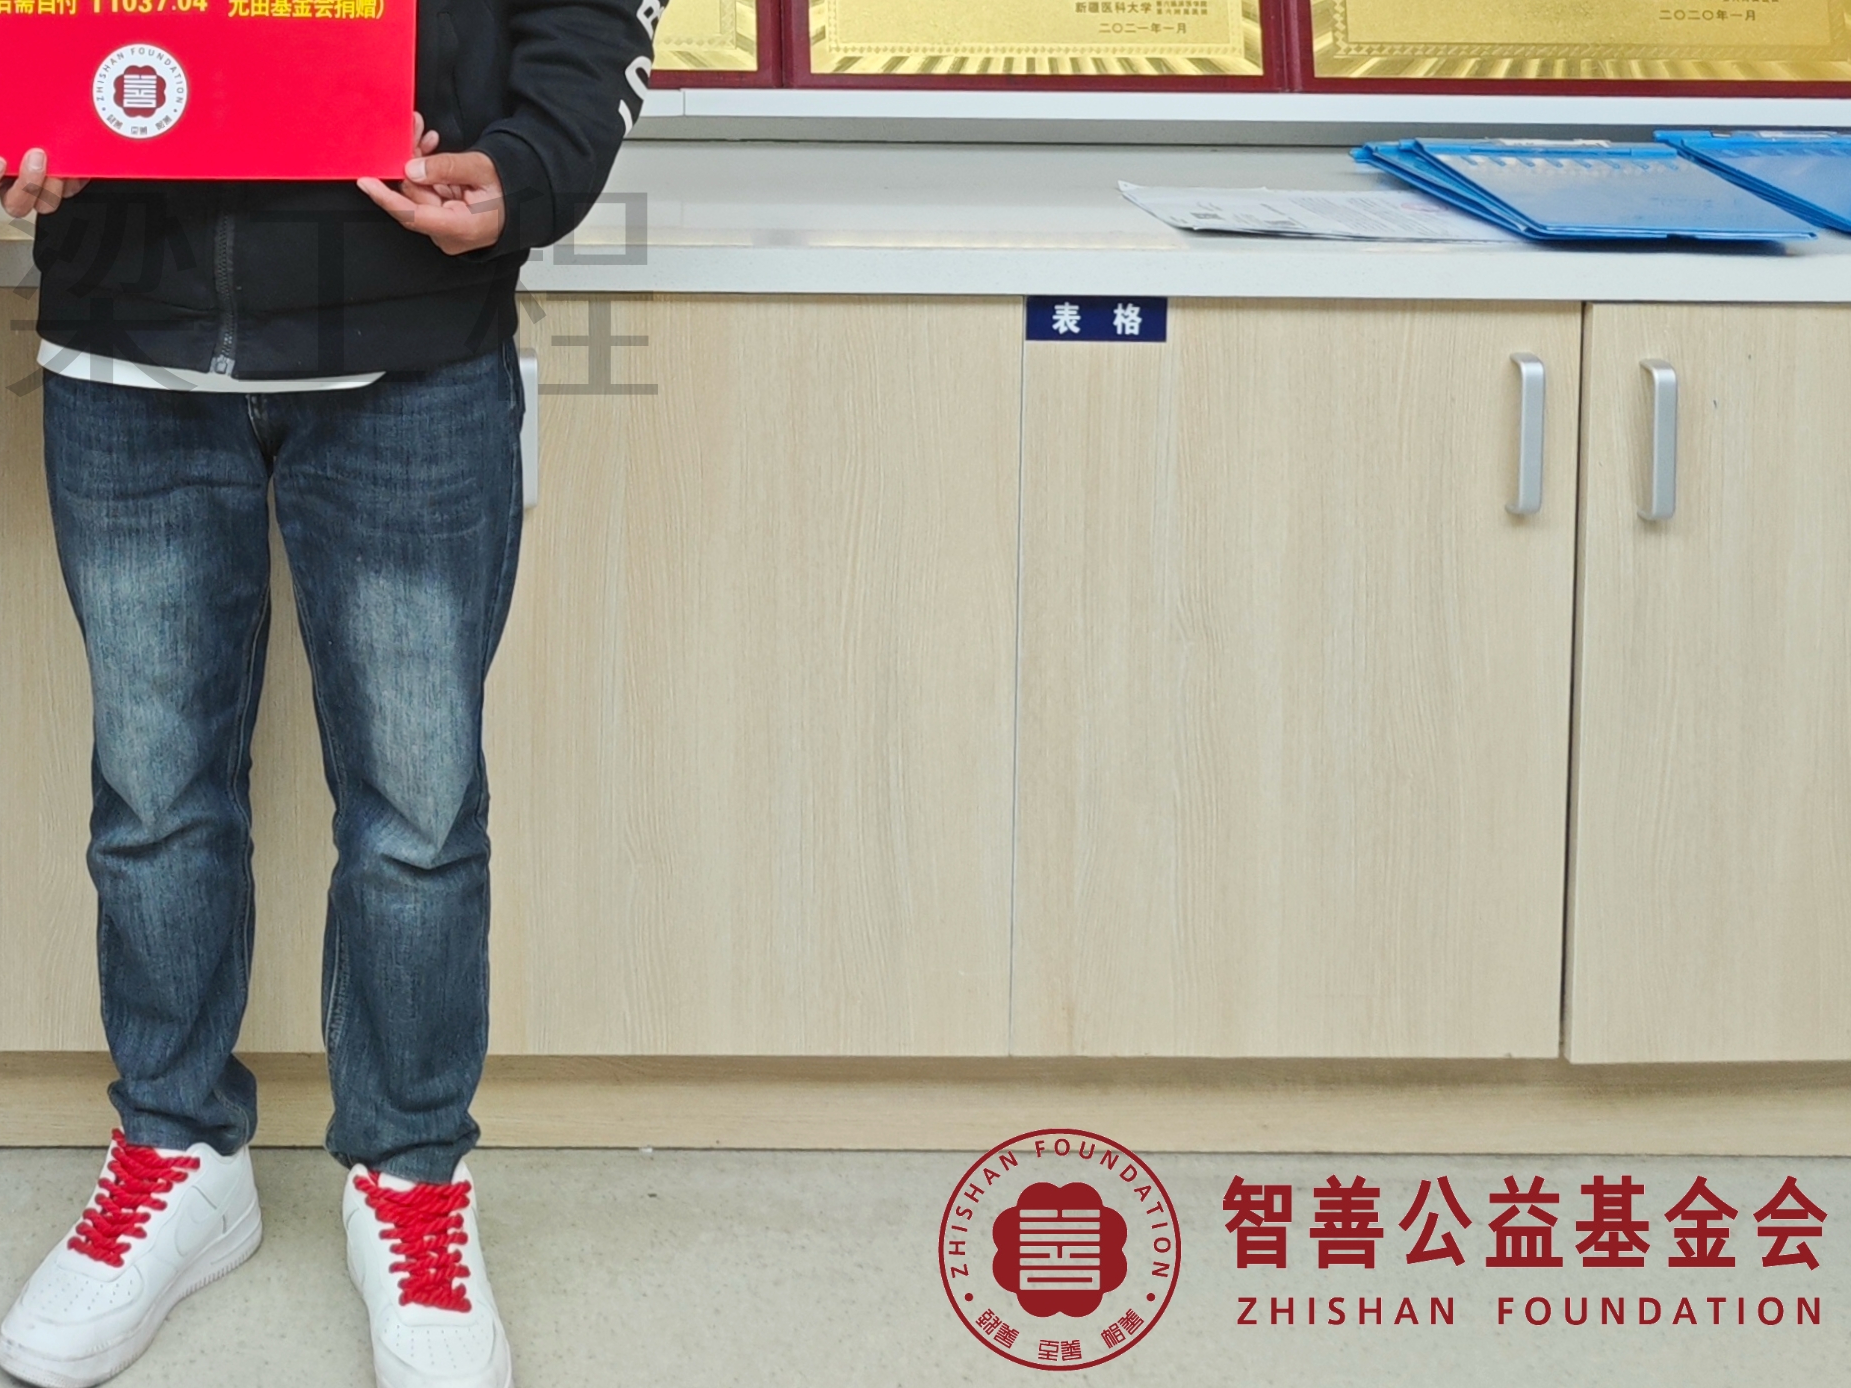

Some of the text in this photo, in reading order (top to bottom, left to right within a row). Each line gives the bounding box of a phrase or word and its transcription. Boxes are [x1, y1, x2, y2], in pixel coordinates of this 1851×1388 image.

[1075, 1, 1152, 14] 新疆医科大学
[96, 47, 184, 104] ZHISHAN FOUNDATION
[1051, 302, 1143, 336] 表格
